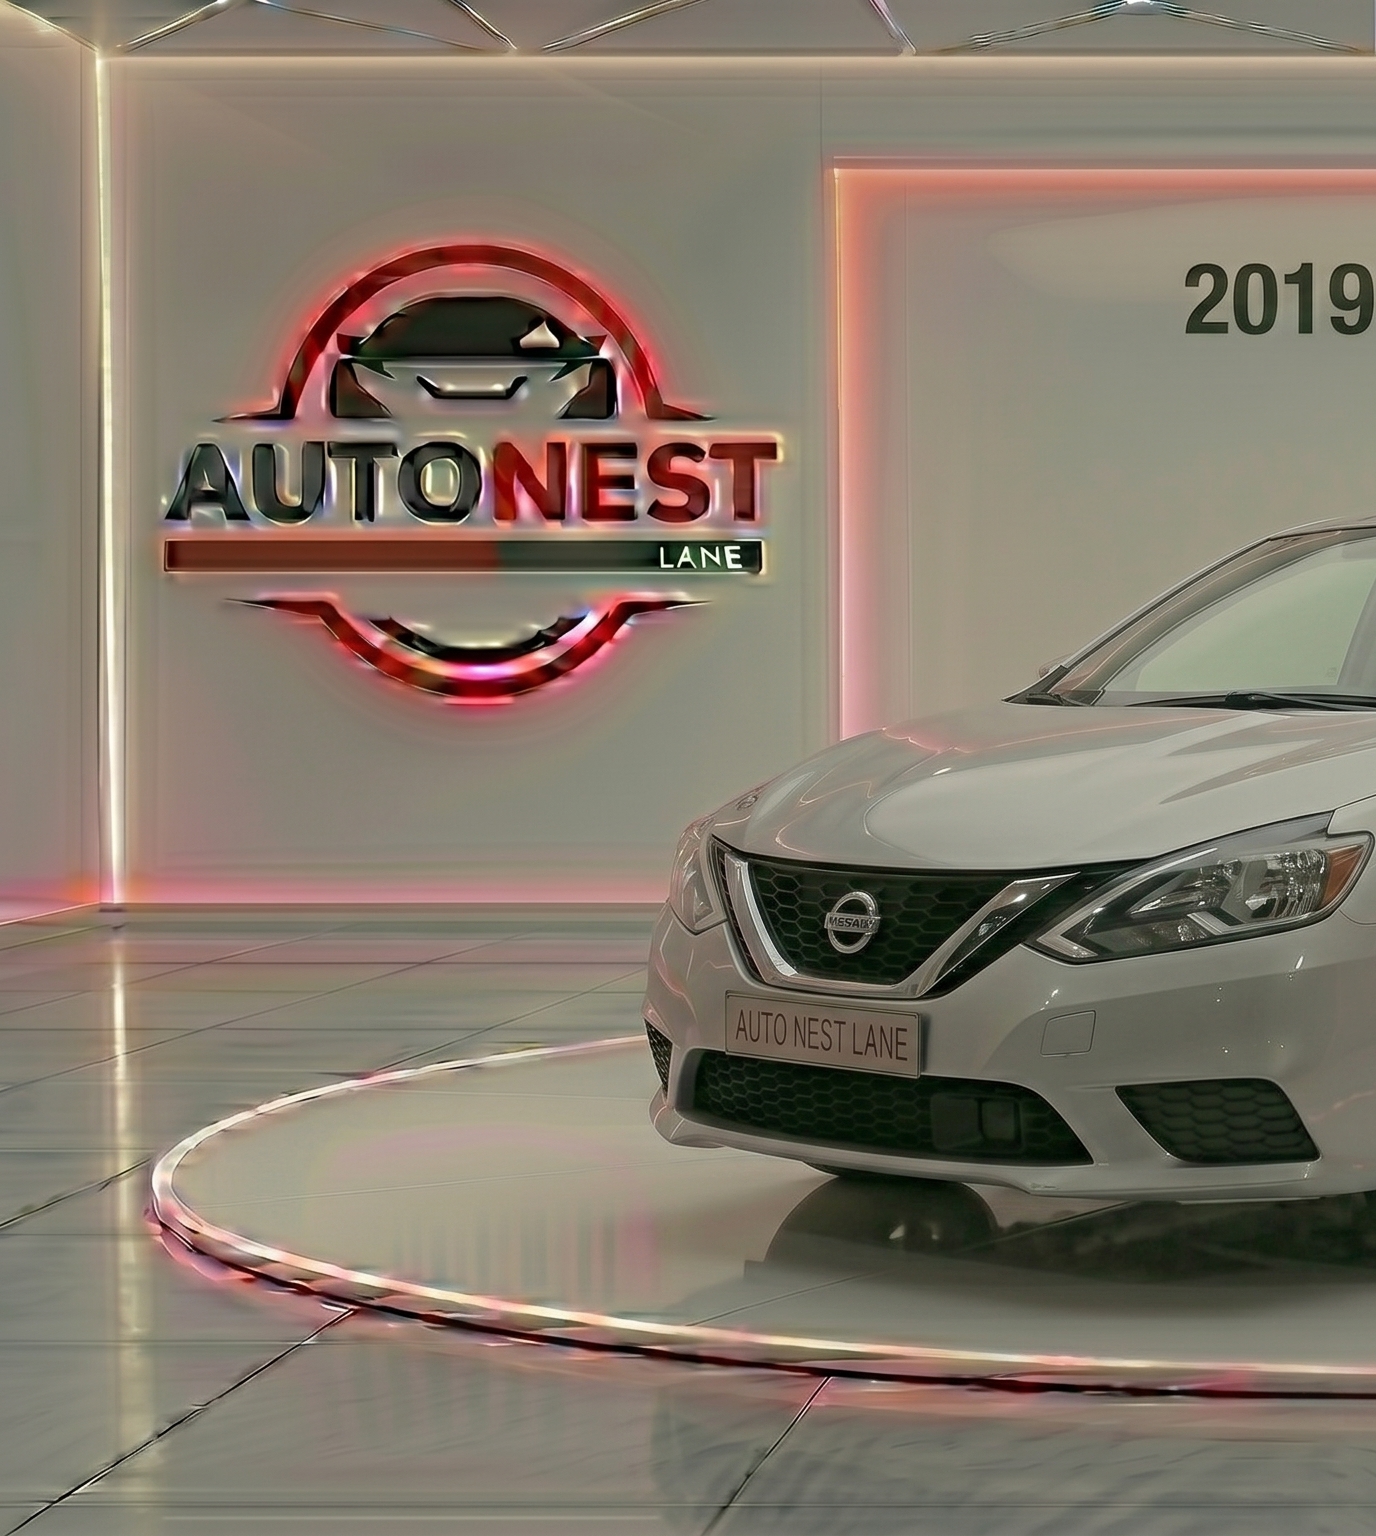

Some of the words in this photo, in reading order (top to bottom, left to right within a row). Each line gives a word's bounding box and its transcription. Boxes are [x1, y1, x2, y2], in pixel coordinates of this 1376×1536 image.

[1184, 262, 1375, 336] 2019
[164, 440, 778, 523] AUTONEST
[659, 545, 743, 569] LANE
[735, 1009, 787, 1046] AUTO
[794, 1015, 846, 1052] NEST
[852, 1022, 908, 1062] LANE
